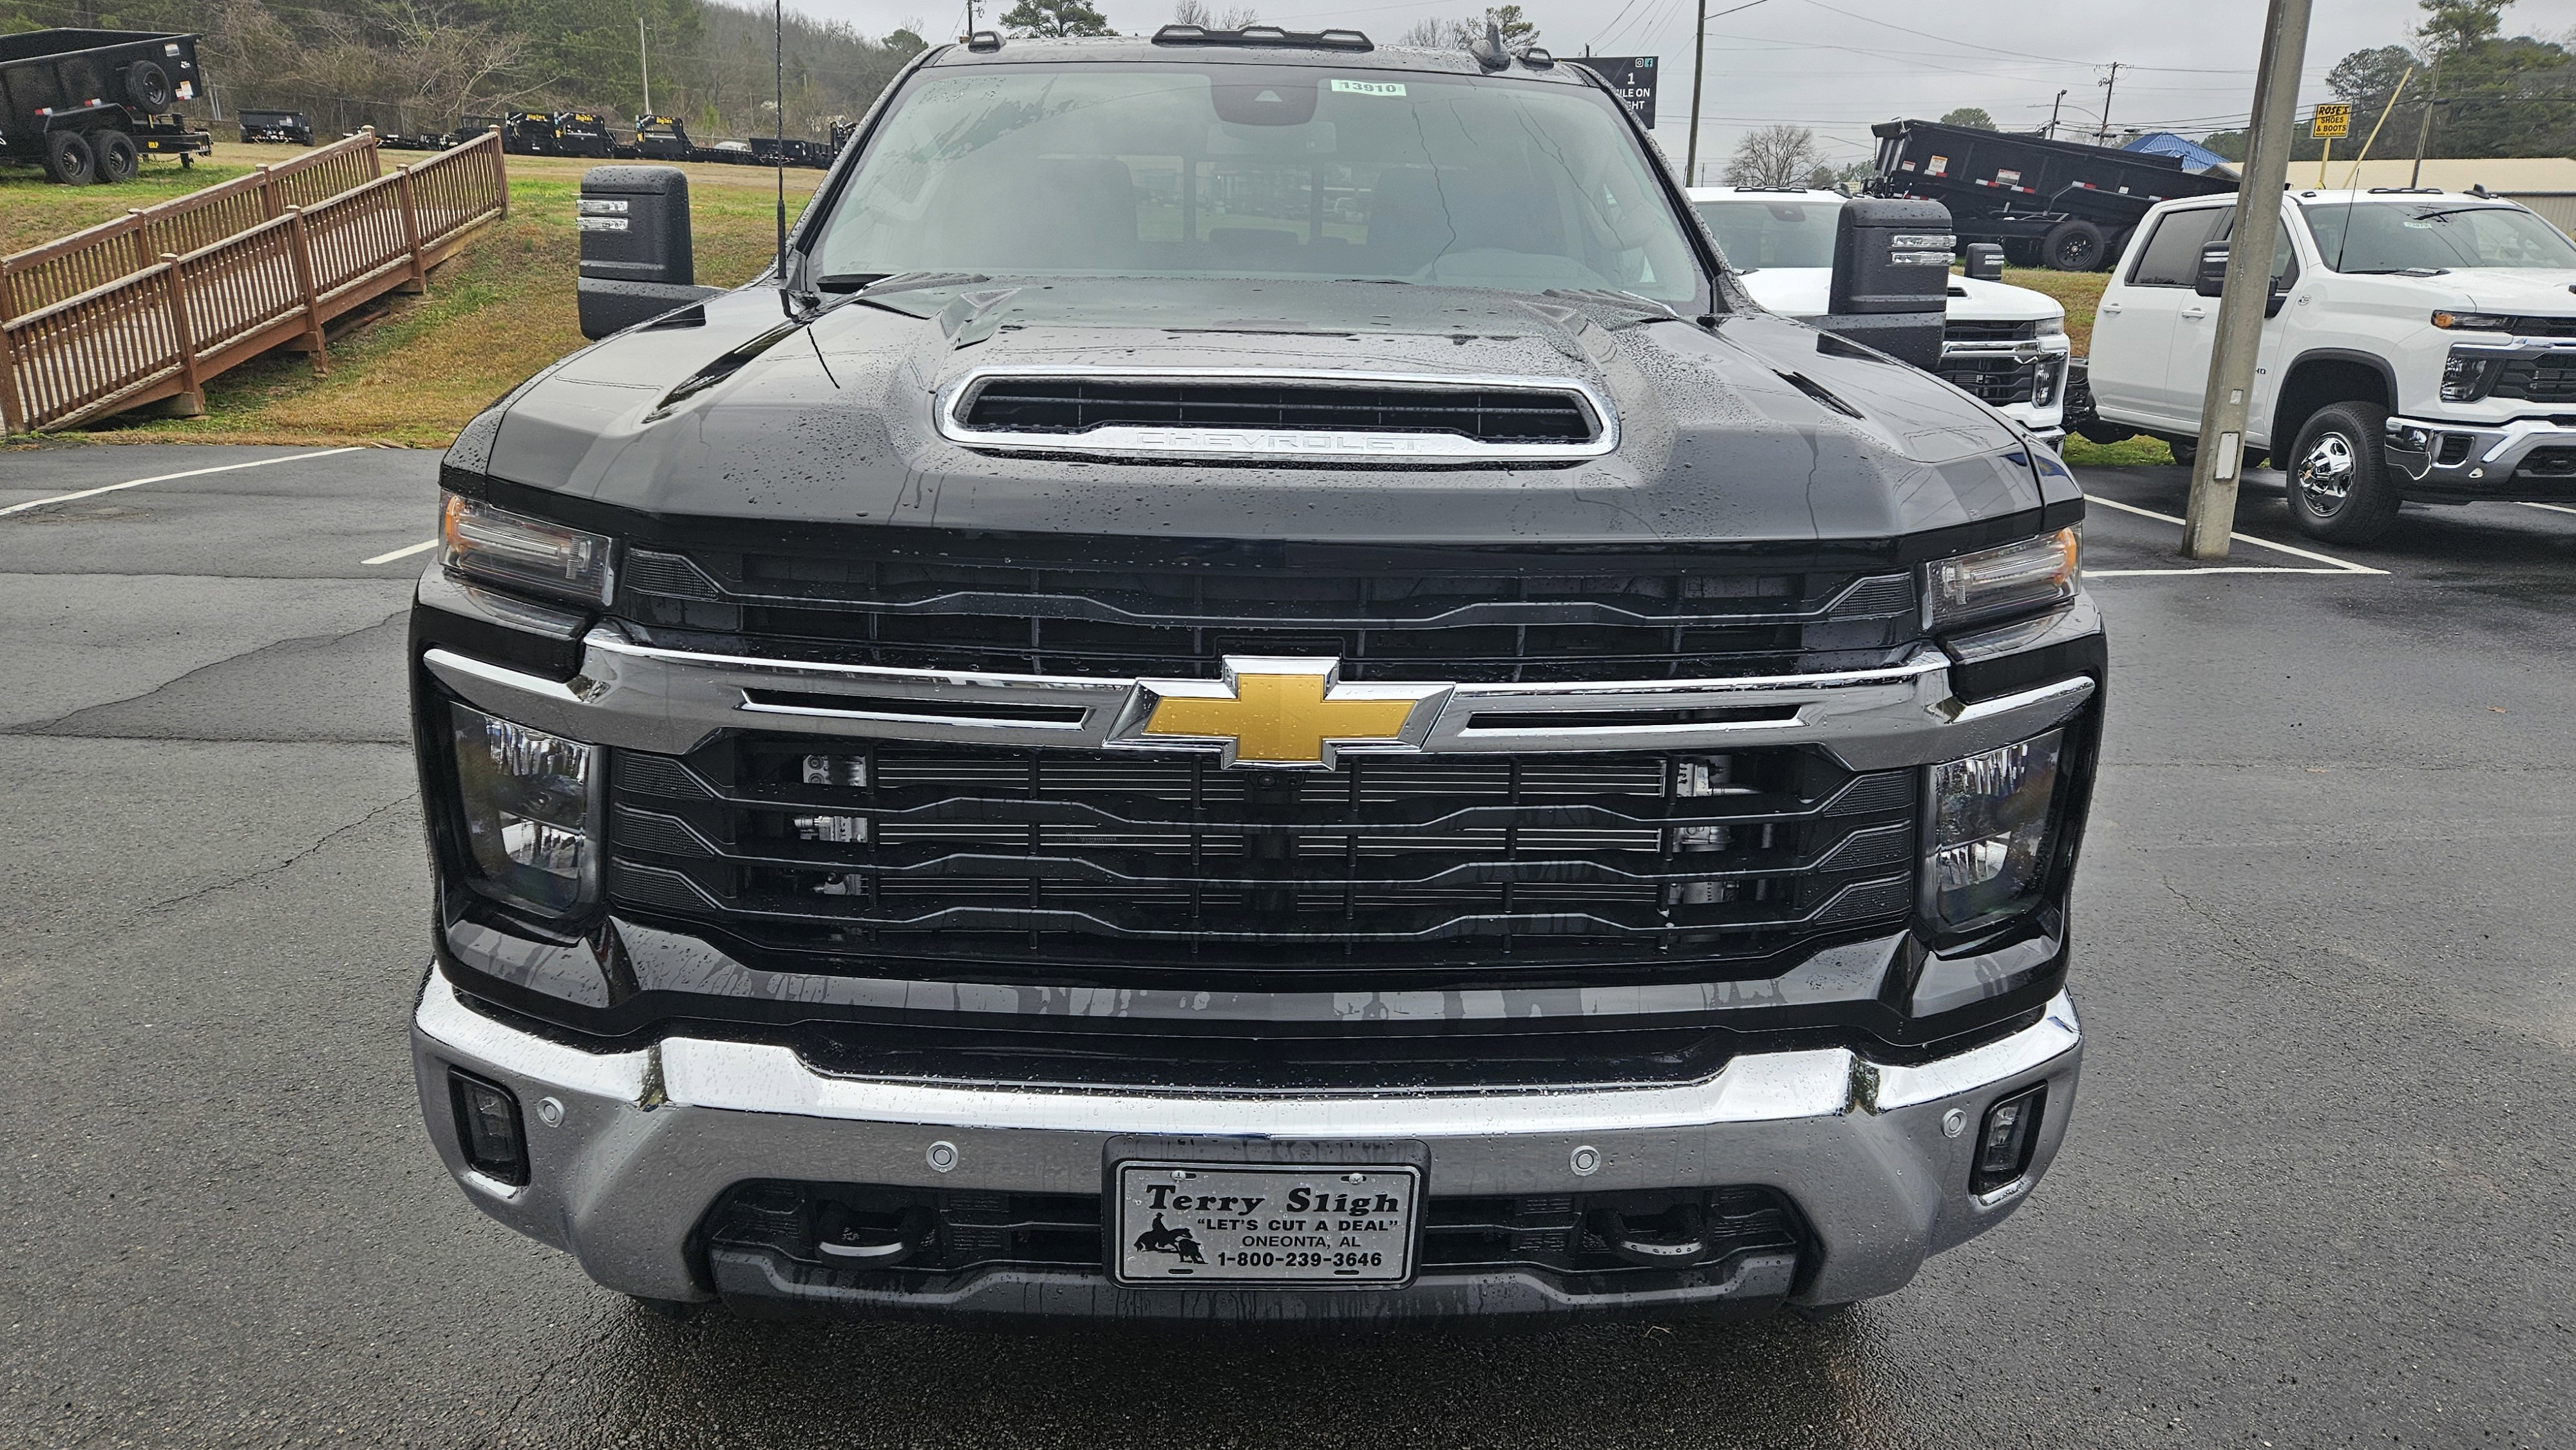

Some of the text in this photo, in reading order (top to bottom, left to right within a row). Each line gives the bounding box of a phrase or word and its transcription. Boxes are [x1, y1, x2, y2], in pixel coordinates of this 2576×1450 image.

[1627, 73, 1635, 84] 1
[1341, 82, 1397, 93] 13910
[1636, 88, 1650, 97] ON
[1627, 100, 1645, 109] GHT
[2318, 106, 2349, 115] ROSE'S
[1136, 431, 1427, 451] CHEVROLET
[1146, 1184, 1399, 1217] Terry Sligh
[1268, 1219, 1306, 1231] CUT
[1314, 1220, 1329, 1231] A
[1242, 1235, 1361, 1250] ONEONTA, AL
[1218, 1251, 1382, 1267] 1-800-239-3646
